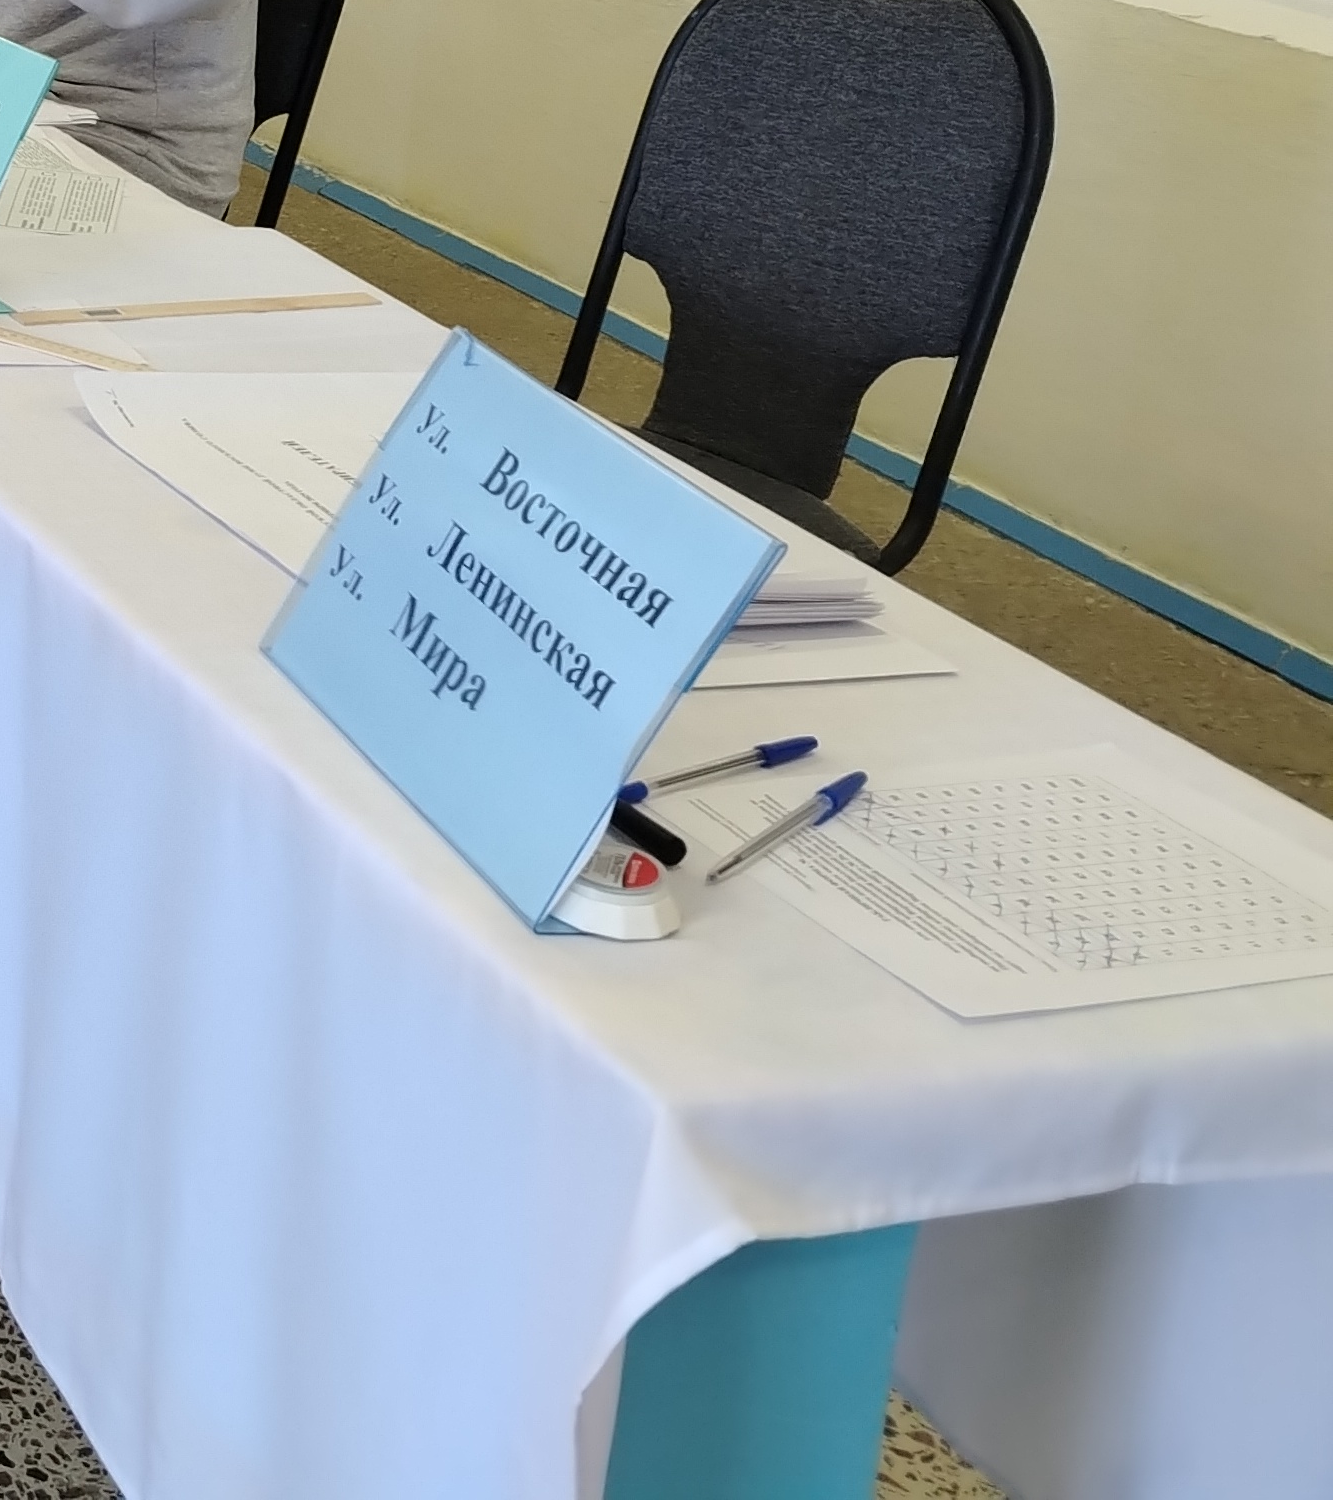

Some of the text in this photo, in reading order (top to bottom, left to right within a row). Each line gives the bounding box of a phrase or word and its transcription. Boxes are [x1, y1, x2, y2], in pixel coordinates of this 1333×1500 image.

[330, 544, 487, 712] Ул. Мира
[368, 473, 618, 712] Ул. Ленинская
[416, 402, 675, 629] Ул. Восточная
